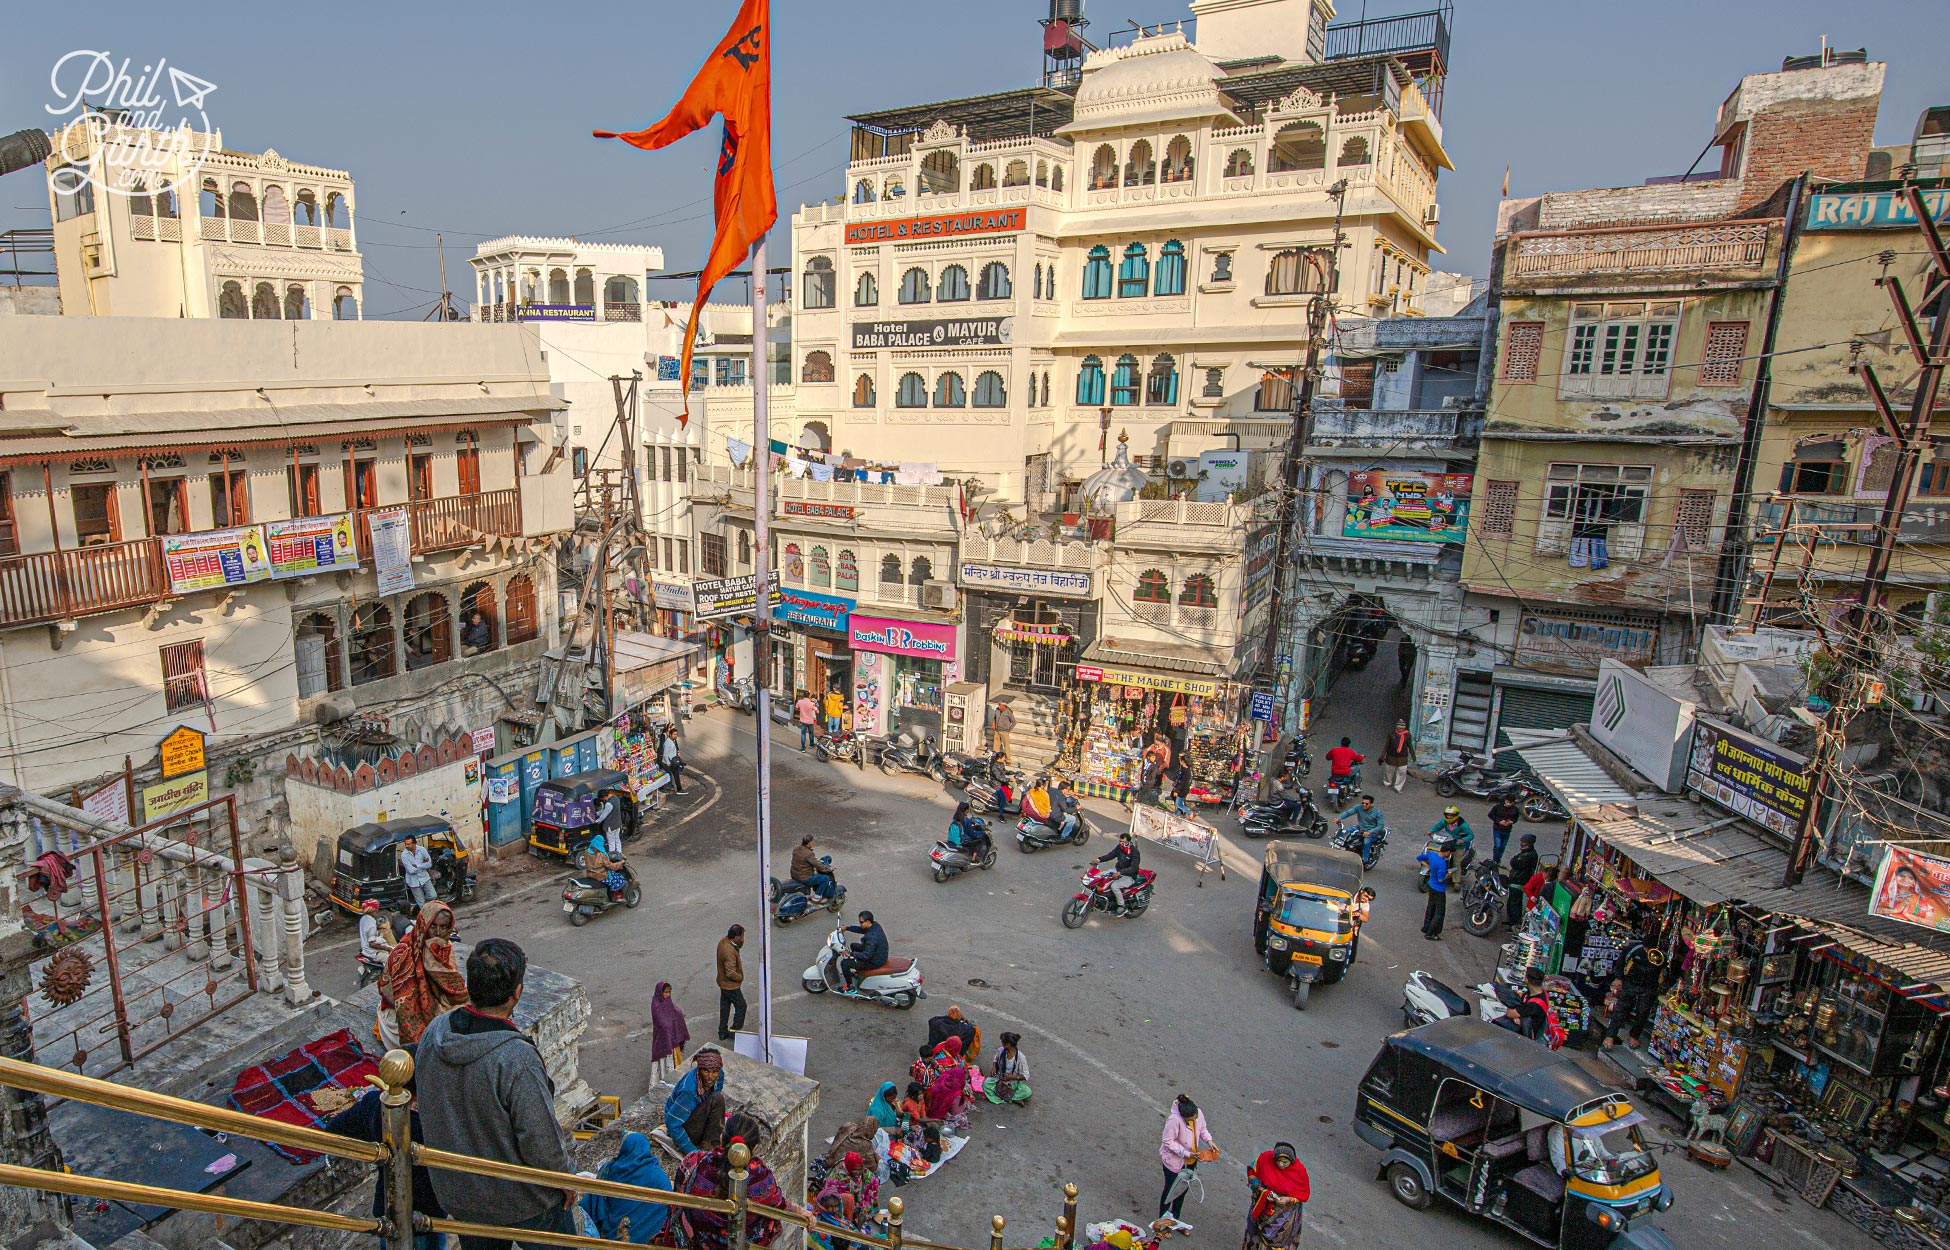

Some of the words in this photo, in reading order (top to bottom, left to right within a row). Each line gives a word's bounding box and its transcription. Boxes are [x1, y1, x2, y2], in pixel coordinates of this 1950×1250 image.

[1817, 195, 1877, 226] RAJ
[849, 225, 894, 241] HOTEL
[897, 223, 908, 236] &
[911, 212, 1019, 235] RESTAURANT
[518, 308, 541, 316] ANNA
[543, 308, 594, 317] RESTAURANT
[873, 323, 907, 333] Hotel
[947, 321, 997, 337] MAYUR
[856, 333, 886, 347] BABA
[888, 332, 930, 347] PALACE
[786, 503, 806, 514] HOTEL
[806, 504, 824, 516] BABA
[825, 506, 850, 518] PALACE
[695, 580, 723, 592] HOTEL
[724, 577, 747, 587] BABA
[747, 572, 777, 585] PACE
[720, 586, 742, 594] MAYUR
[698, 594, 719, 603] ROOF
[719, 592, 734, 600] TOP
[780, 592, 821, 611] Mayur
[787, 610, 838, 628] RESTAURANT
[854, 630, 886, 646] baskin
[885, 627, 913, 649] BR
[911, 639, 946, 653] robbins
[1522, 617, 1650, 650] Sunbright
[1114, 672, 1134, 683] THE
[1136, 676, 1182, 690] MAGNET
[1184, 682, 1212, 694] SHOP
[1255, 698, 1271, 706] TOILET
[1716, 739, 1729, 756] श्री
[1728, 746, 1765, 773] जगन्नाथ
[1764, 760, 1785, 781] भोग
[148, 789, 180, 806] जगदीश
[182, 781, 204, 795] मंदिर
[1717, 761, 1733, 775] एवं
[1732, 766, 1775, 794] धार्मिक
[1775, 786, 1805, 811] केन्द्र
